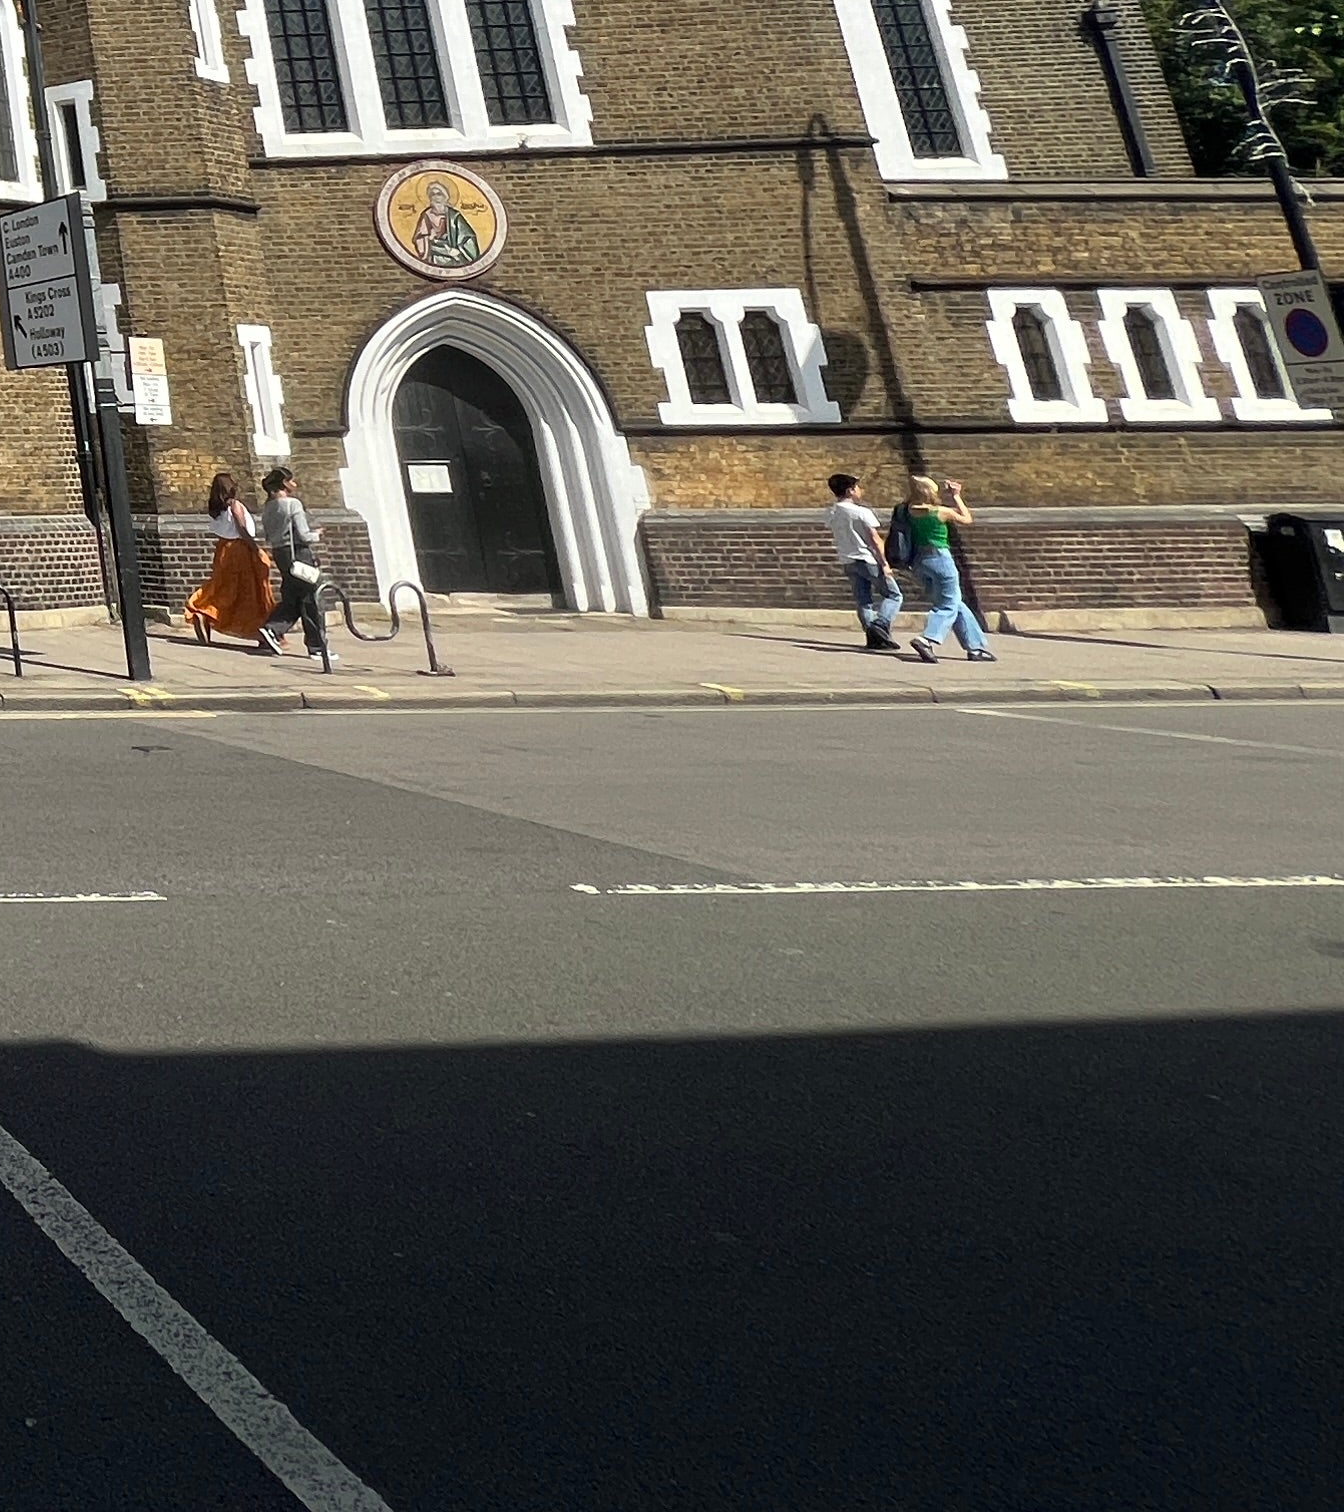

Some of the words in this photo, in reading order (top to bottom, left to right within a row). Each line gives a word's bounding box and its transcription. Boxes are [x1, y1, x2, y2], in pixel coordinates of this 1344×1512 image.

[11, 214, 40, 232] London
[4, 234, 31, 250] Euston
[6, 249, 37, 265] Camden
[37, 242, 59, 258] Town
[8, 265, 32, 281] A400
[24, 290, 47, 305] Kings
[47, 285, 72, 302] Cross
[1273, 289, 1316, 306] ZONE
[27, 304, 55, 320] A5202
[29, 325, 65, 341] Holloway
[32, 341, 65, 360] (A503)
